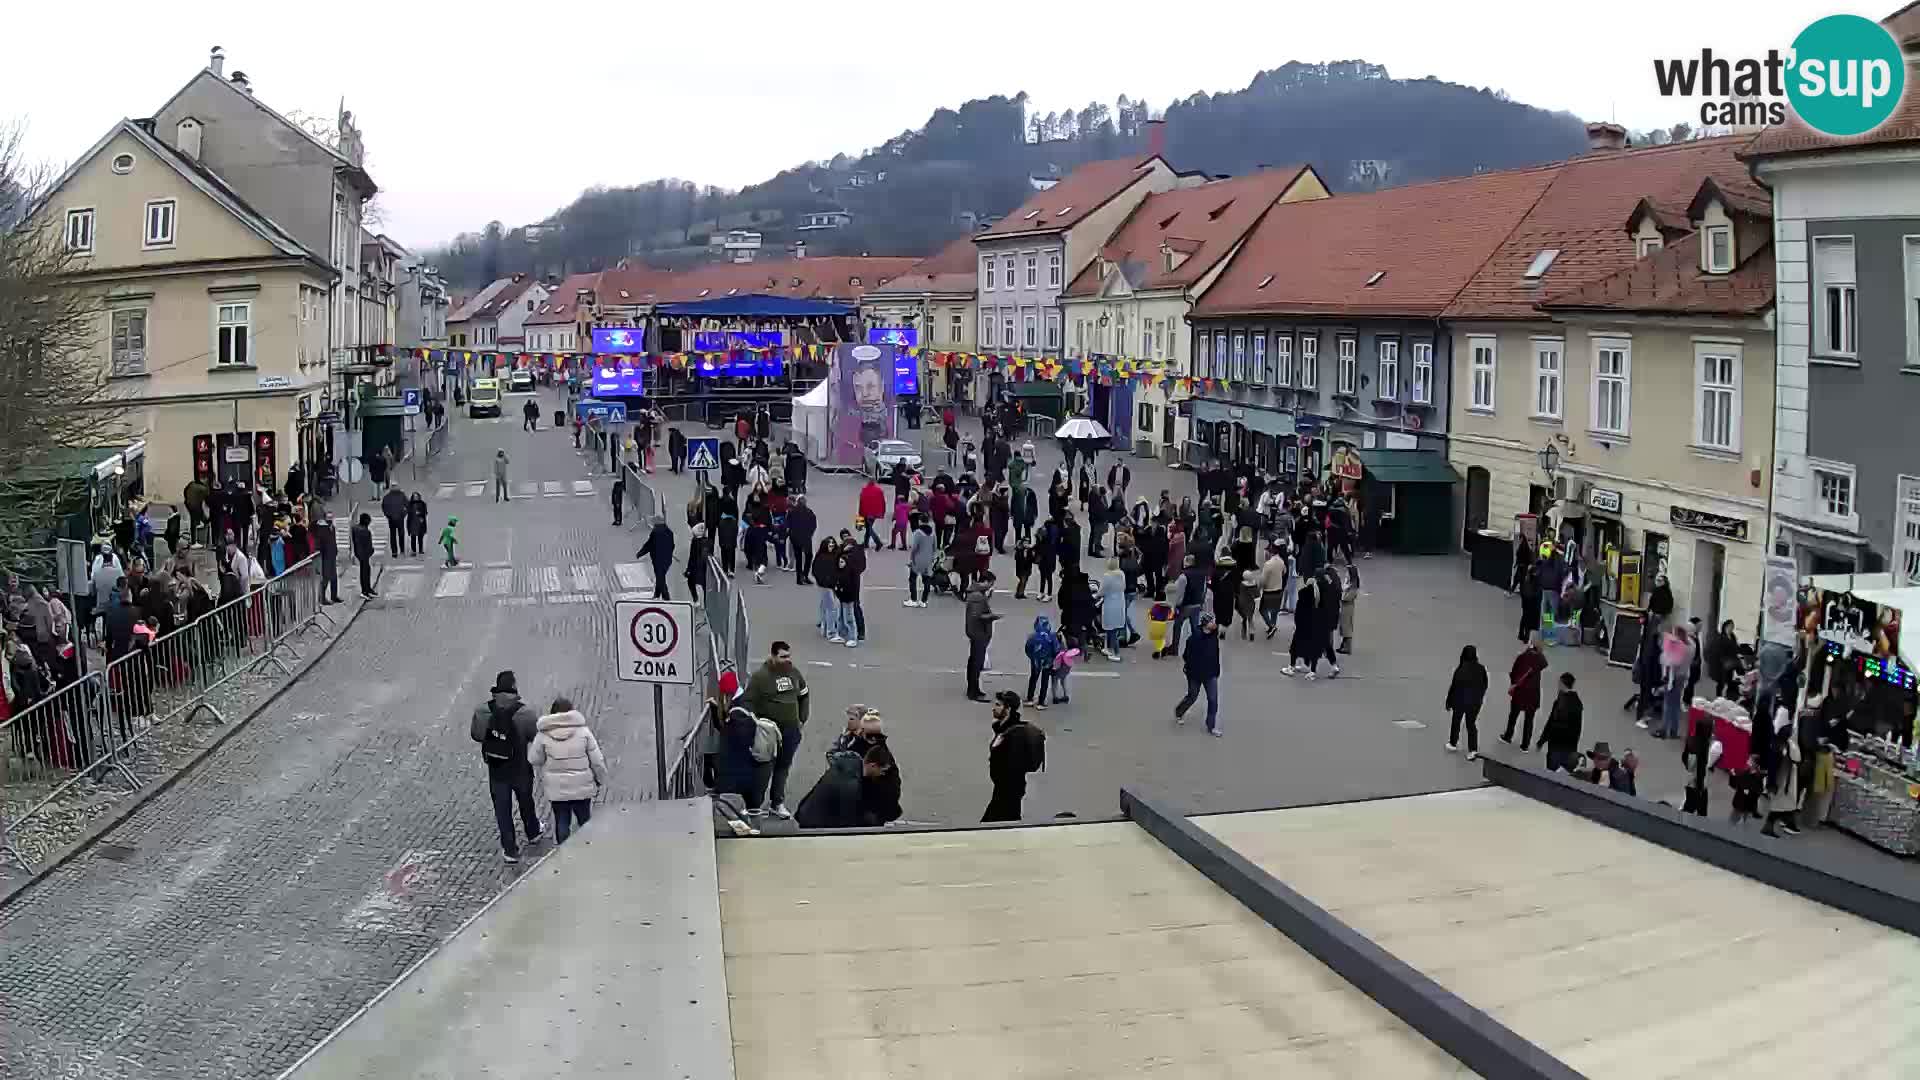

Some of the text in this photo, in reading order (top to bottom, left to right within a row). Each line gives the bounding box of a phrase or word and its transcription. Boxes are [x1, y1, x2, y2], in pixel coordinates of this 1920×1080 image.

[407, 392, 416, 404] P
[643, 623, 667, 645] 30
[633, 660, 678, 677] ZONA
